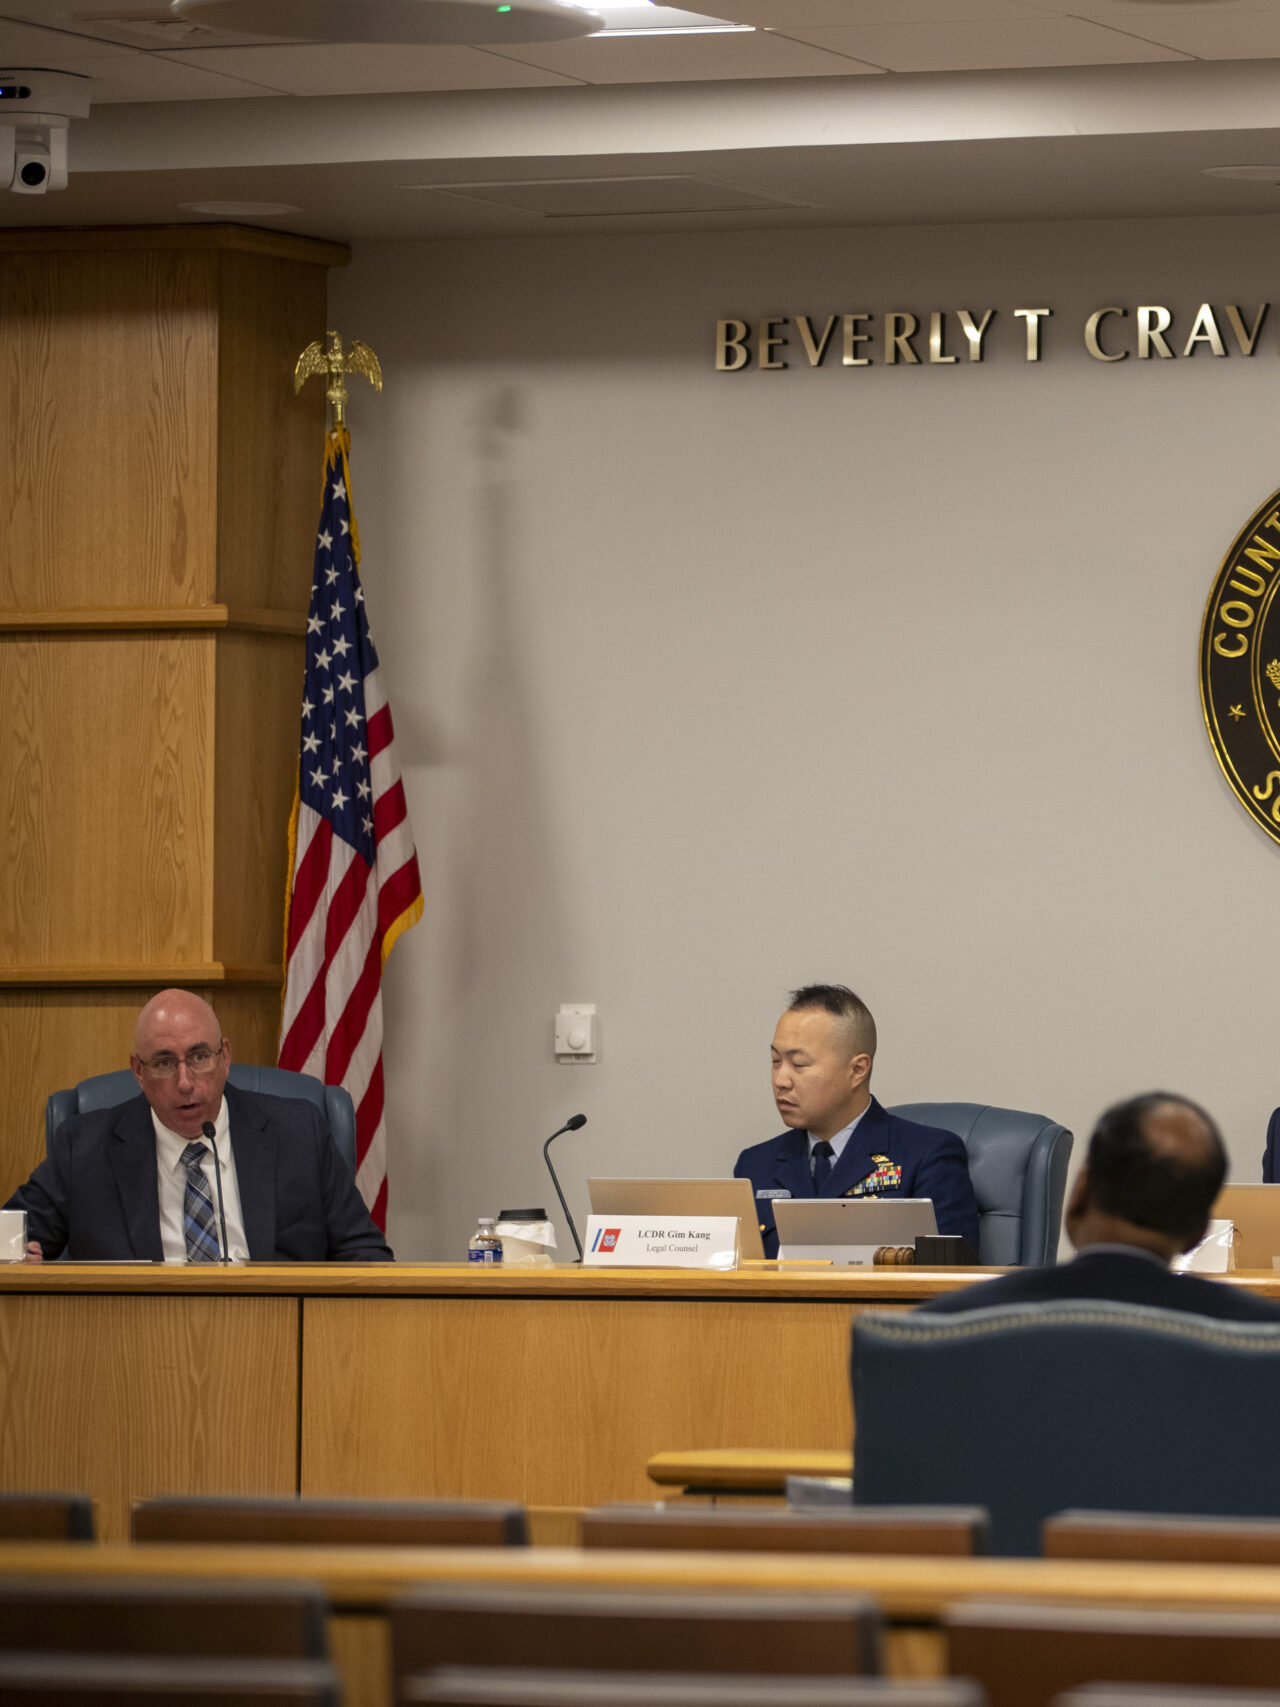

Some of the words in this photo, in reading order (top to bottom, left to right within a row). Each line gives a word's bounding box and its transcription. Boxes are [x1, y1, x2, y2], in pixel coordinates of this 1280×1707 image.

[715, 308, 996, 371] BEVERLY
[1013, 307, 1051, 362] T
[638, 1229, 665, 1239] LCDR
[667, 1229, 686, 1239] Gim
[688, 1230, 711, 1241] Kang
[646, 1243, 667, 1254] Legal
[668, 1243, 698, 1253] Counsel
